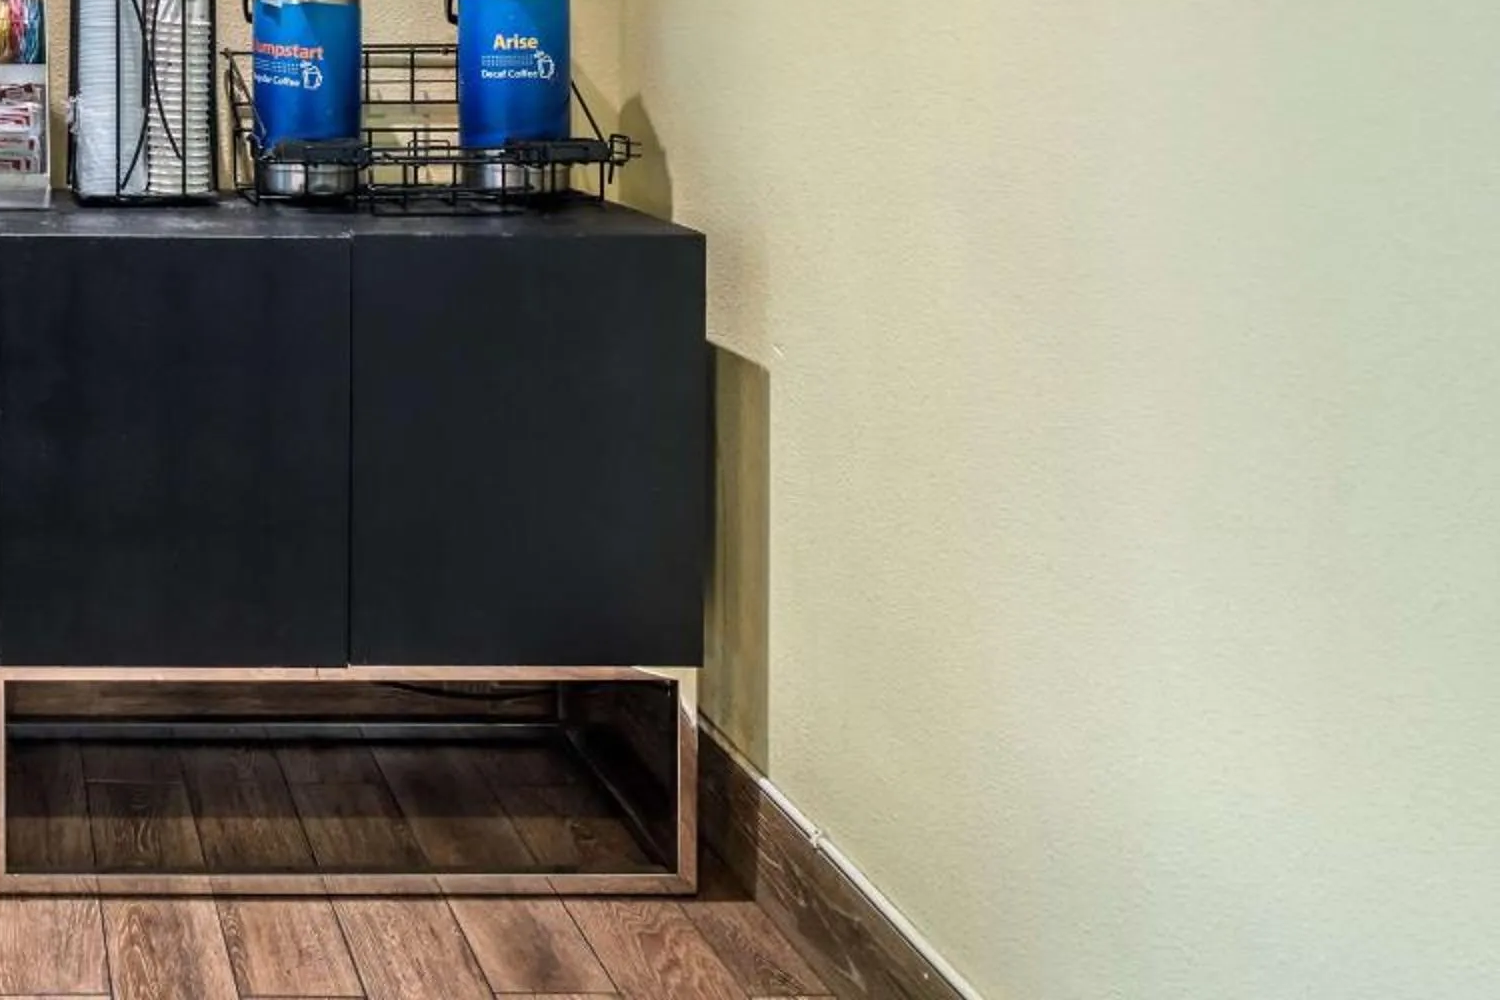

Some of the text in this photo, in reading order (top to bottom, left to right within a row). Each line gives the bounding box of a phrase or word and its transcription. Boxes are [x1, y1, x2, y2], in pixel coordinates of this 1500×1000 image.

[493, 33, 538, 50] Arise
[481, 69, 538, 79] Decaf Coffee
[273, 75, 301, 87] Coffee
